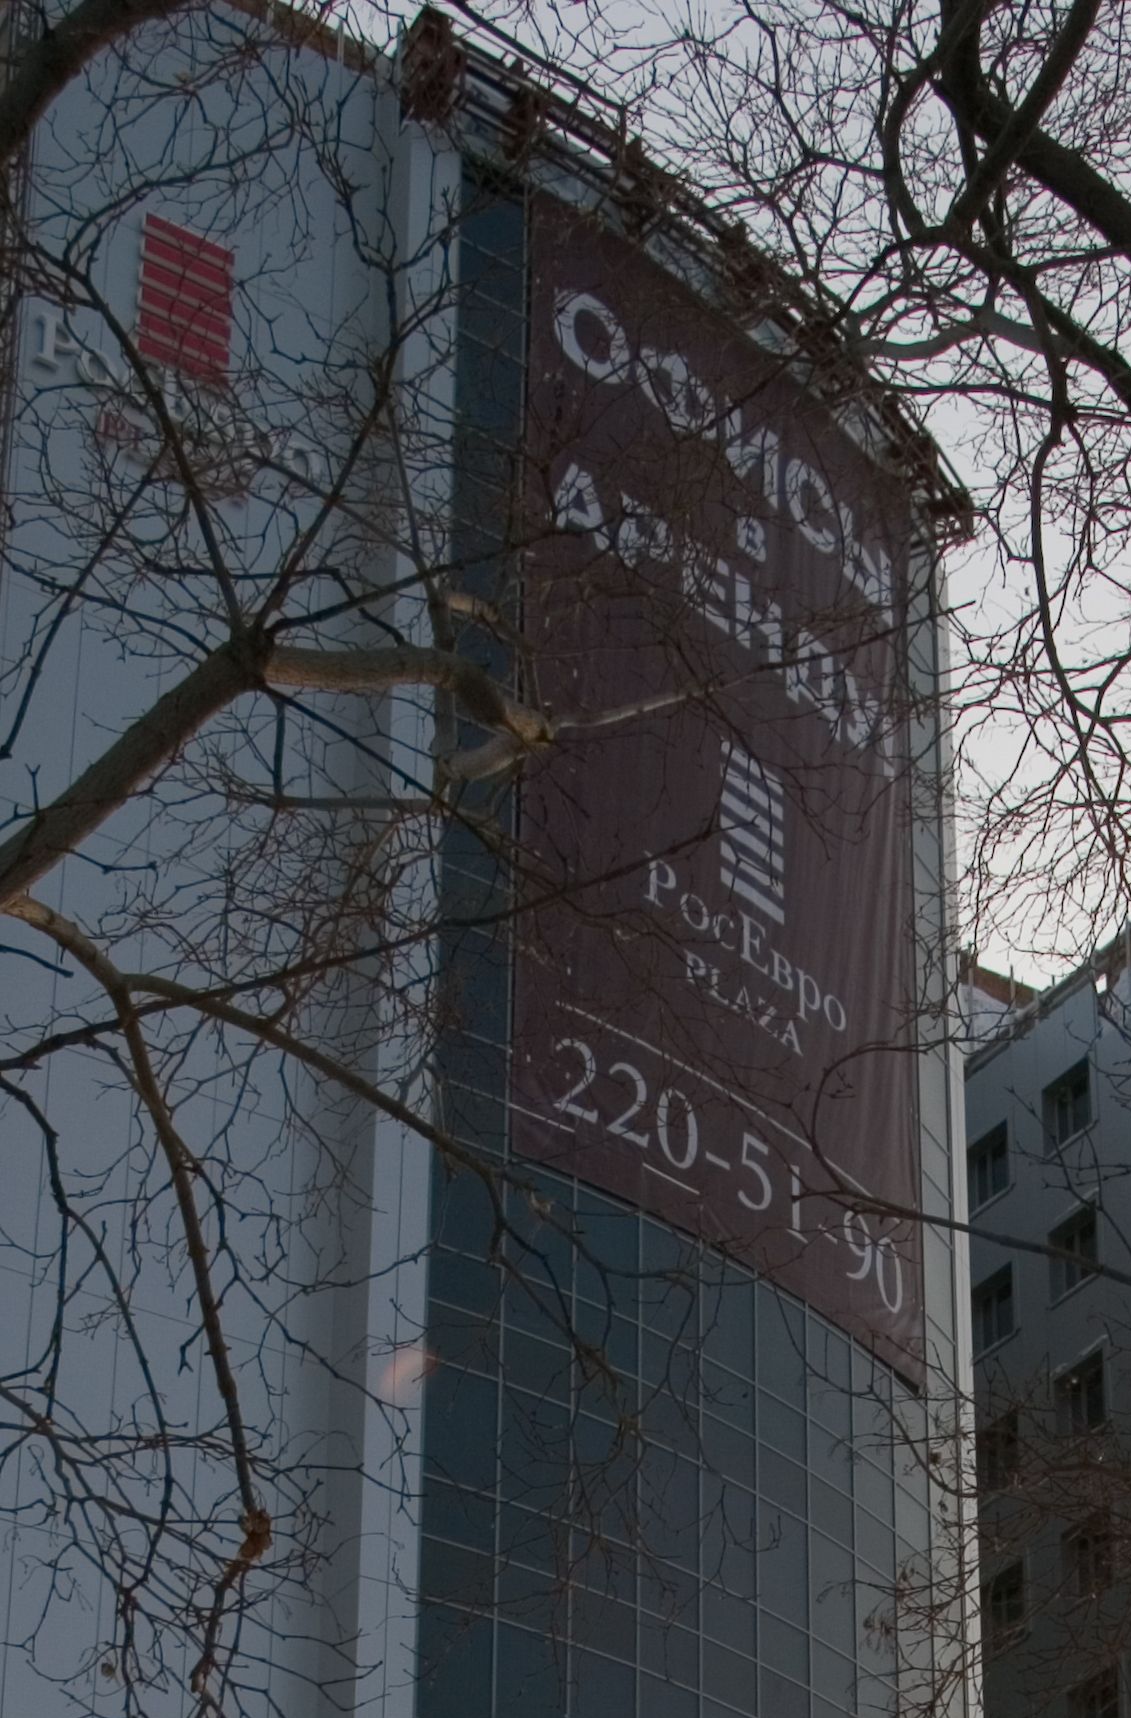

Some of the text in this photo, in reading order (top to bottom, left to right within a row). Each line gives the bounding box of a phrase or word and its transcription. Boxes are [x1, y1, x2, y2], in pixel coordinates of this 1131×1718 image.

[553, 286, 894, 628] ОФИСЫ
[684, 949, 803, 1056] PLAZA
[553, 1038, 903, 1314] 220-51-90
